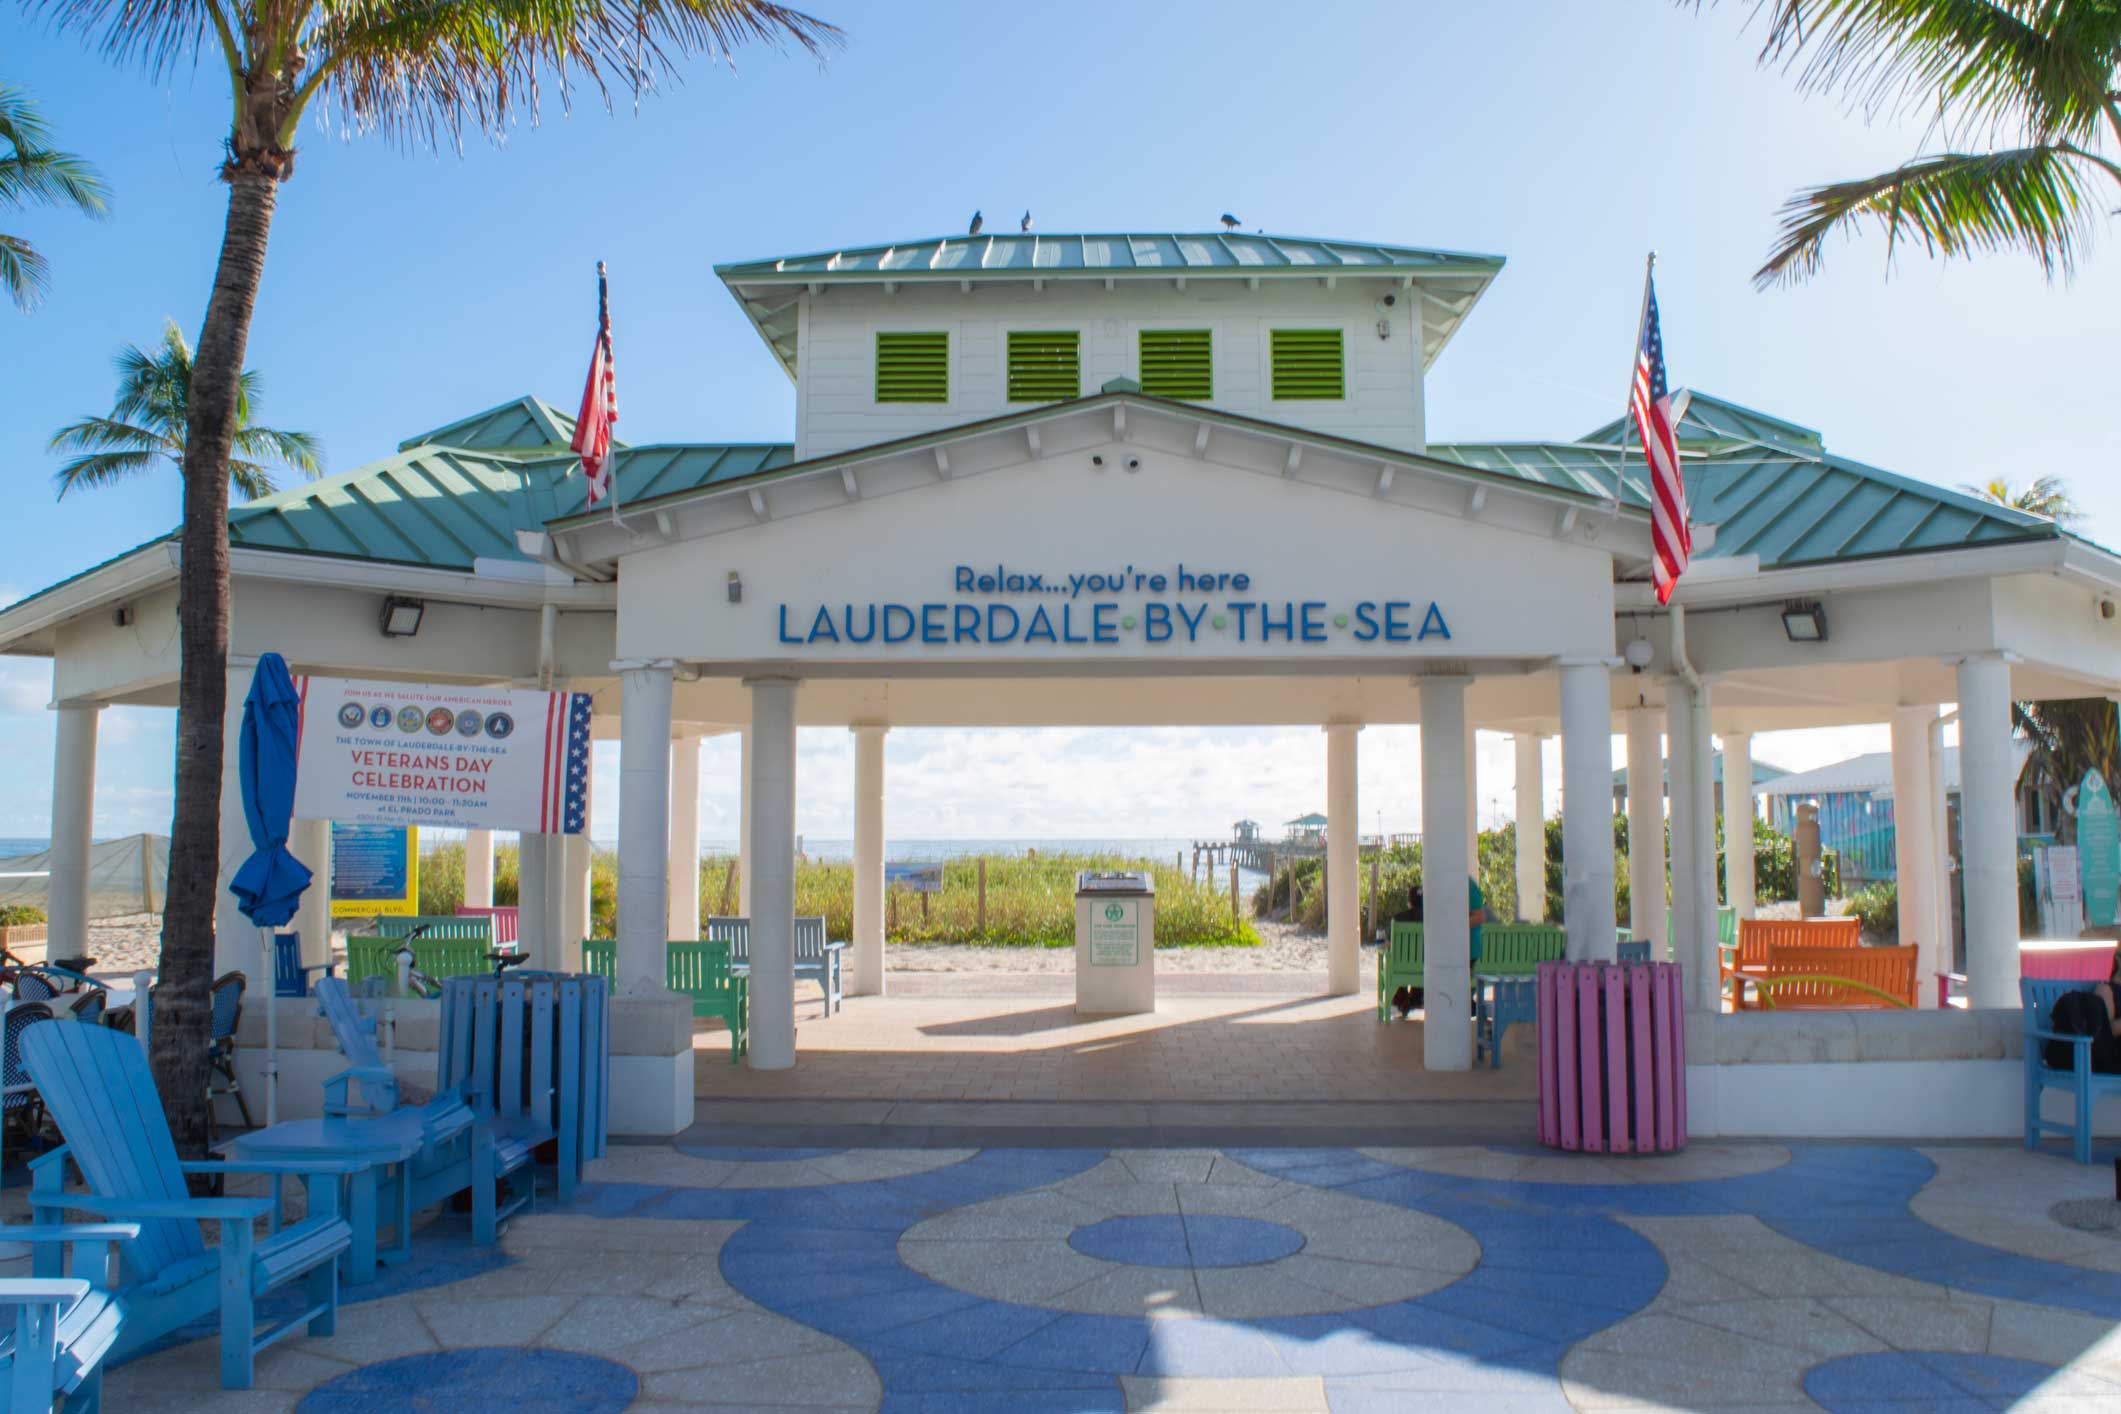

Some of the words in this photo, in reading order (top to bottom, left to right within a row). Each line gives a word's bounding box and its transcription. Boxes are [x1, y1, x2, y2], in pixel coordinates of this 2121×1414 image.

[1178, 563, 1250, 592] here
[778, 602, 1121, 644] LAUDERDALE
[1145, 601, 1208, 643] BY
[1228, 601, 1328, 643] THE
[1354, 601, 1452, 643] SEA
[344, 689, 362, 697] JOIN
[363, 690, 371, 698] US
[397, 692, 423, 700] SALUTE
[442, 695, 481, 704] AMERICAN
[482, 697, 513, 706] HEROES
[336, 736, 352, 745] THE
[355, 737, 381, 747] TOWN
[383, 739, 396, 747] OF
[351, 750, 449, 771] VETERANS
[456, 756, 494, 773] DAY
[352, 771, 486, 793] CELEBRATION
[346, 791, 395, 802] NOVEMBER
[420, 796, 445, 805] 10:00
[401, 806, 431, 815] PRADO
[433, 808, 456, 817] PARK
